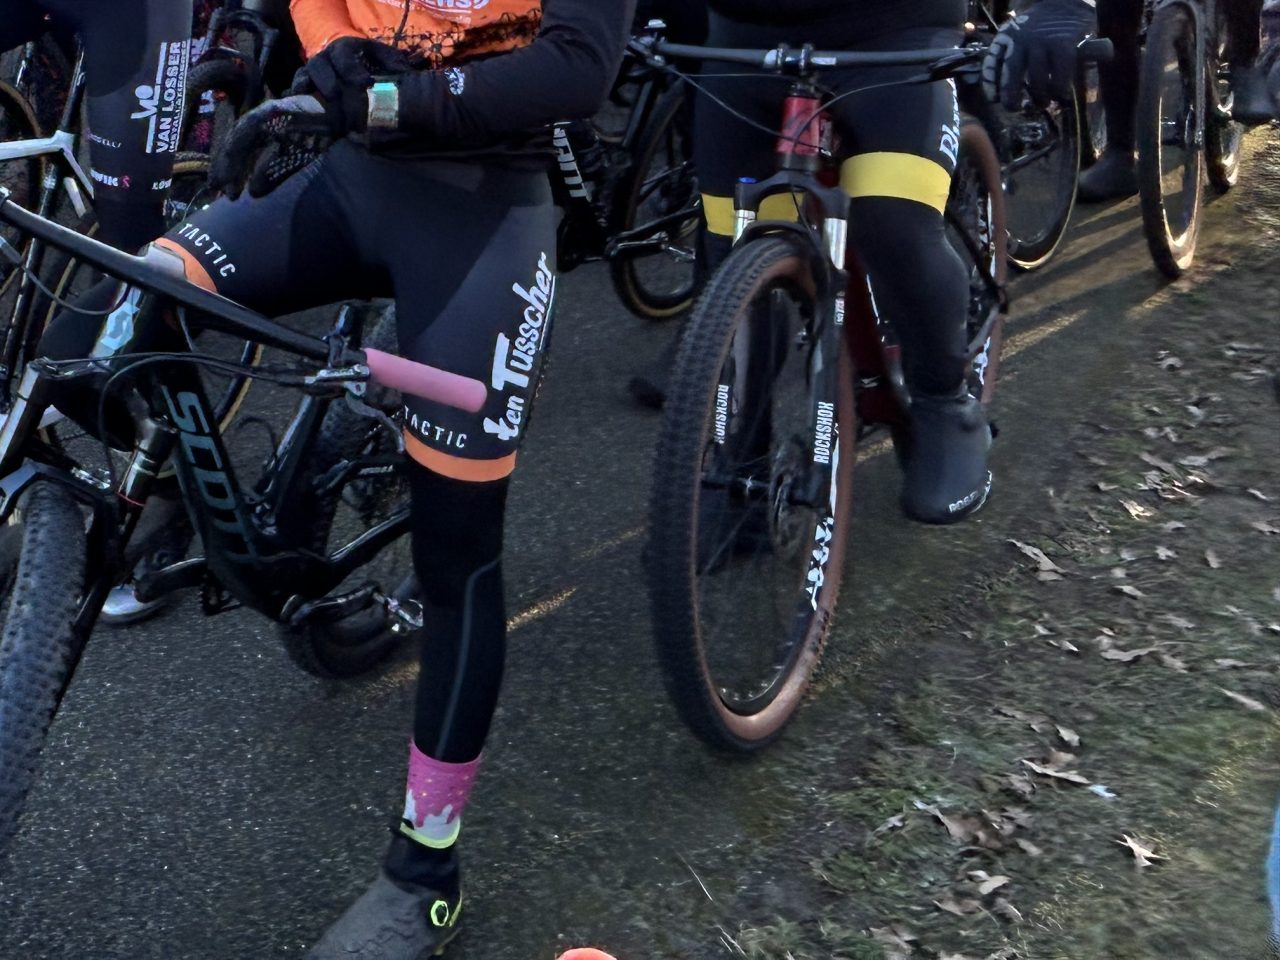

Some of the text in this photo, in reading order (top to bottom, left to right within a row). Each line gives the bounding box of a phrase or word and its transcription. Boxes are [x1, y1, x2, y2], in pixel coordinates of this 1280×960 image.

[156, 41, 182, 153] VAN LOSSER
[179, 223, 236, 278] TACTIC
[483, 251, 553, 441] ten Tusscher
[404, 404, 467, 448] TACTIC
[813, 401, 834, 464] ROCKSHOX
